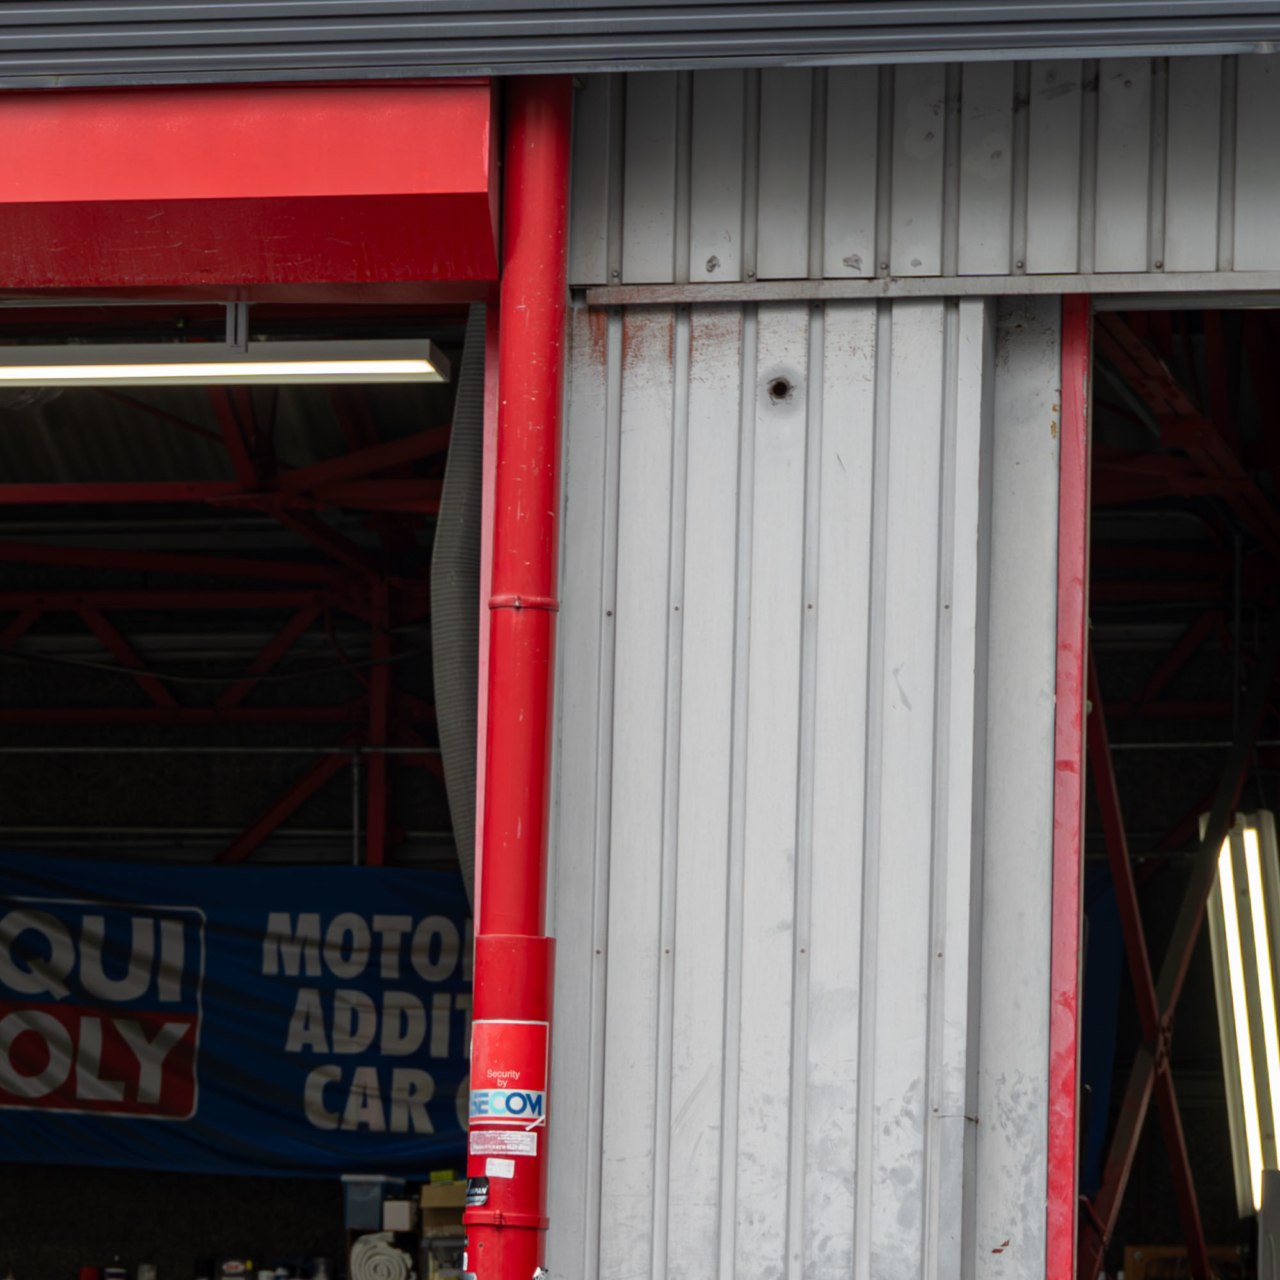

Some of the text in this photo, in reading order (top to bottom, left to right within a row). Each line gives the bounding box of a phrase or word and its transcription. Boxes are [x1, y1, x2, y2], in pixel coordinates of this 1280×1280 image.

[261, 911, 473, 983] MOTO
[486, 1069, 520, 1079] Security
[497, 1079, 507, 1087] by
[303, 1064, 435, 1136] CAR
[470, 1091, 542, 1116] SECOM
